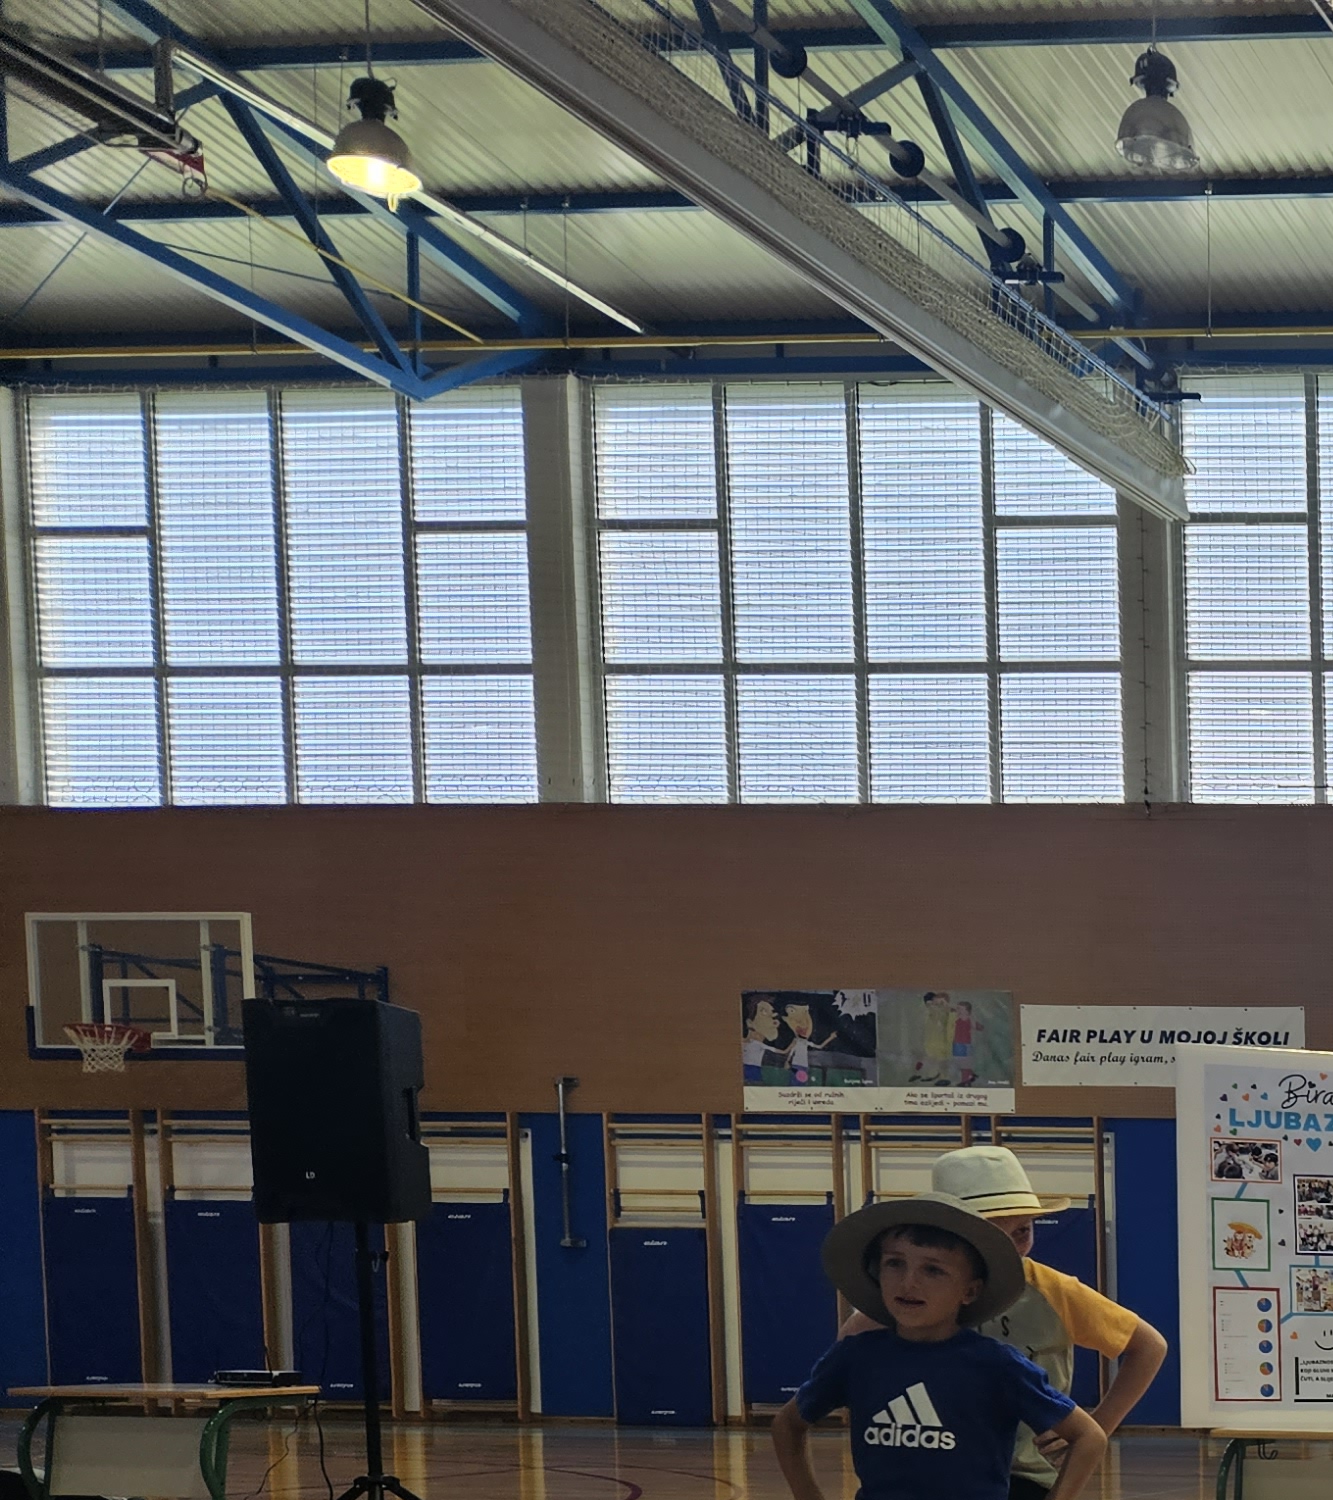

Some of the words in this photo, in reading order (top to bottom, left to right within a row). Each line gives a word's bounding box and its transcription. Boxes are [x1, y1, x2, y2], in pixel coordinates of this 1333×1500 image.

[1036, 1029, 1081, 1044] FAIR
[1085, 1029, 1137, 1044] PLAY
[1139, 1030, 1153, 1044] U
[1159, 1031, 1227, 1045] MOJOJ
[1231, 1027, 1290, 1046] ŠKOLI
[1032, 1051, 1070, 1063] Danas
[1073, 1051, 1096, 1065] fair
[1099, 1051, 1126, 1065] play
[1129, 1051, 1168, 1066] igram,
[863, 1422, 956, 1450] adidas
